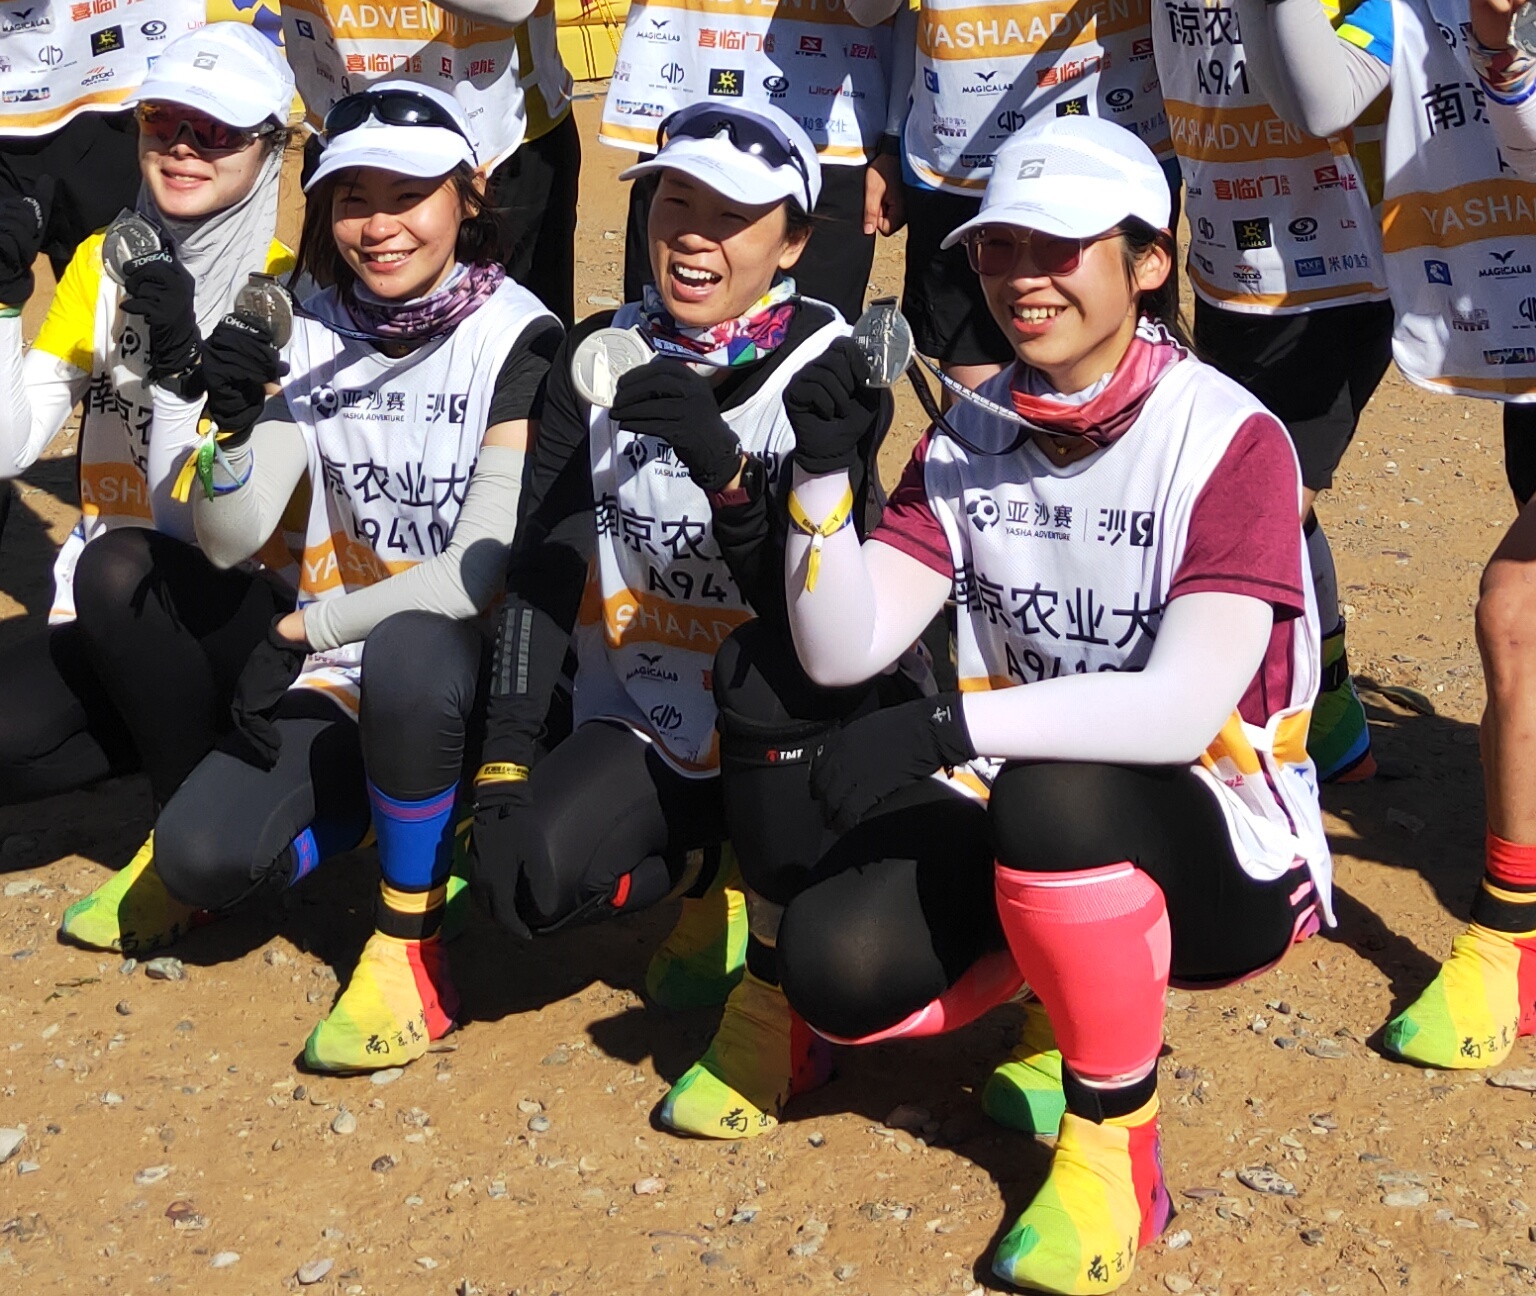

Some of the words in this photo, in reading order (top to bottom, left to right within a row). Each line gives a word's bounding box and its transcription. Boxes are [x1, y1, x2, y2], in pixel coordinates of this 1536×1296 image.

[2, 19, 50, 32] MAGICALAB
[697, 28, 764, 49] 喜临门
[346, 54, 410, 73] 喜临门
[1036, 57, 1100, 88] 喜临门
[962, 83, 1014, 94] MAGICALAB
[1212, 176, 1280, 201] 喜临门
[1299, 259, 1323, 272] MXF
[1479, 265, 1532, 277] MAGICALAB
[342, 389, 405, 411] 亚沙赛
[1006, 500, 1073, 530] 亚沙赛
[1005, 527, 1033, 538] YASHA
[1034, 530, 1071, 542] ADVENTURE
[626, 666, 678, 682] MAGICALAB
[780, 748, 803, 760] TMT
